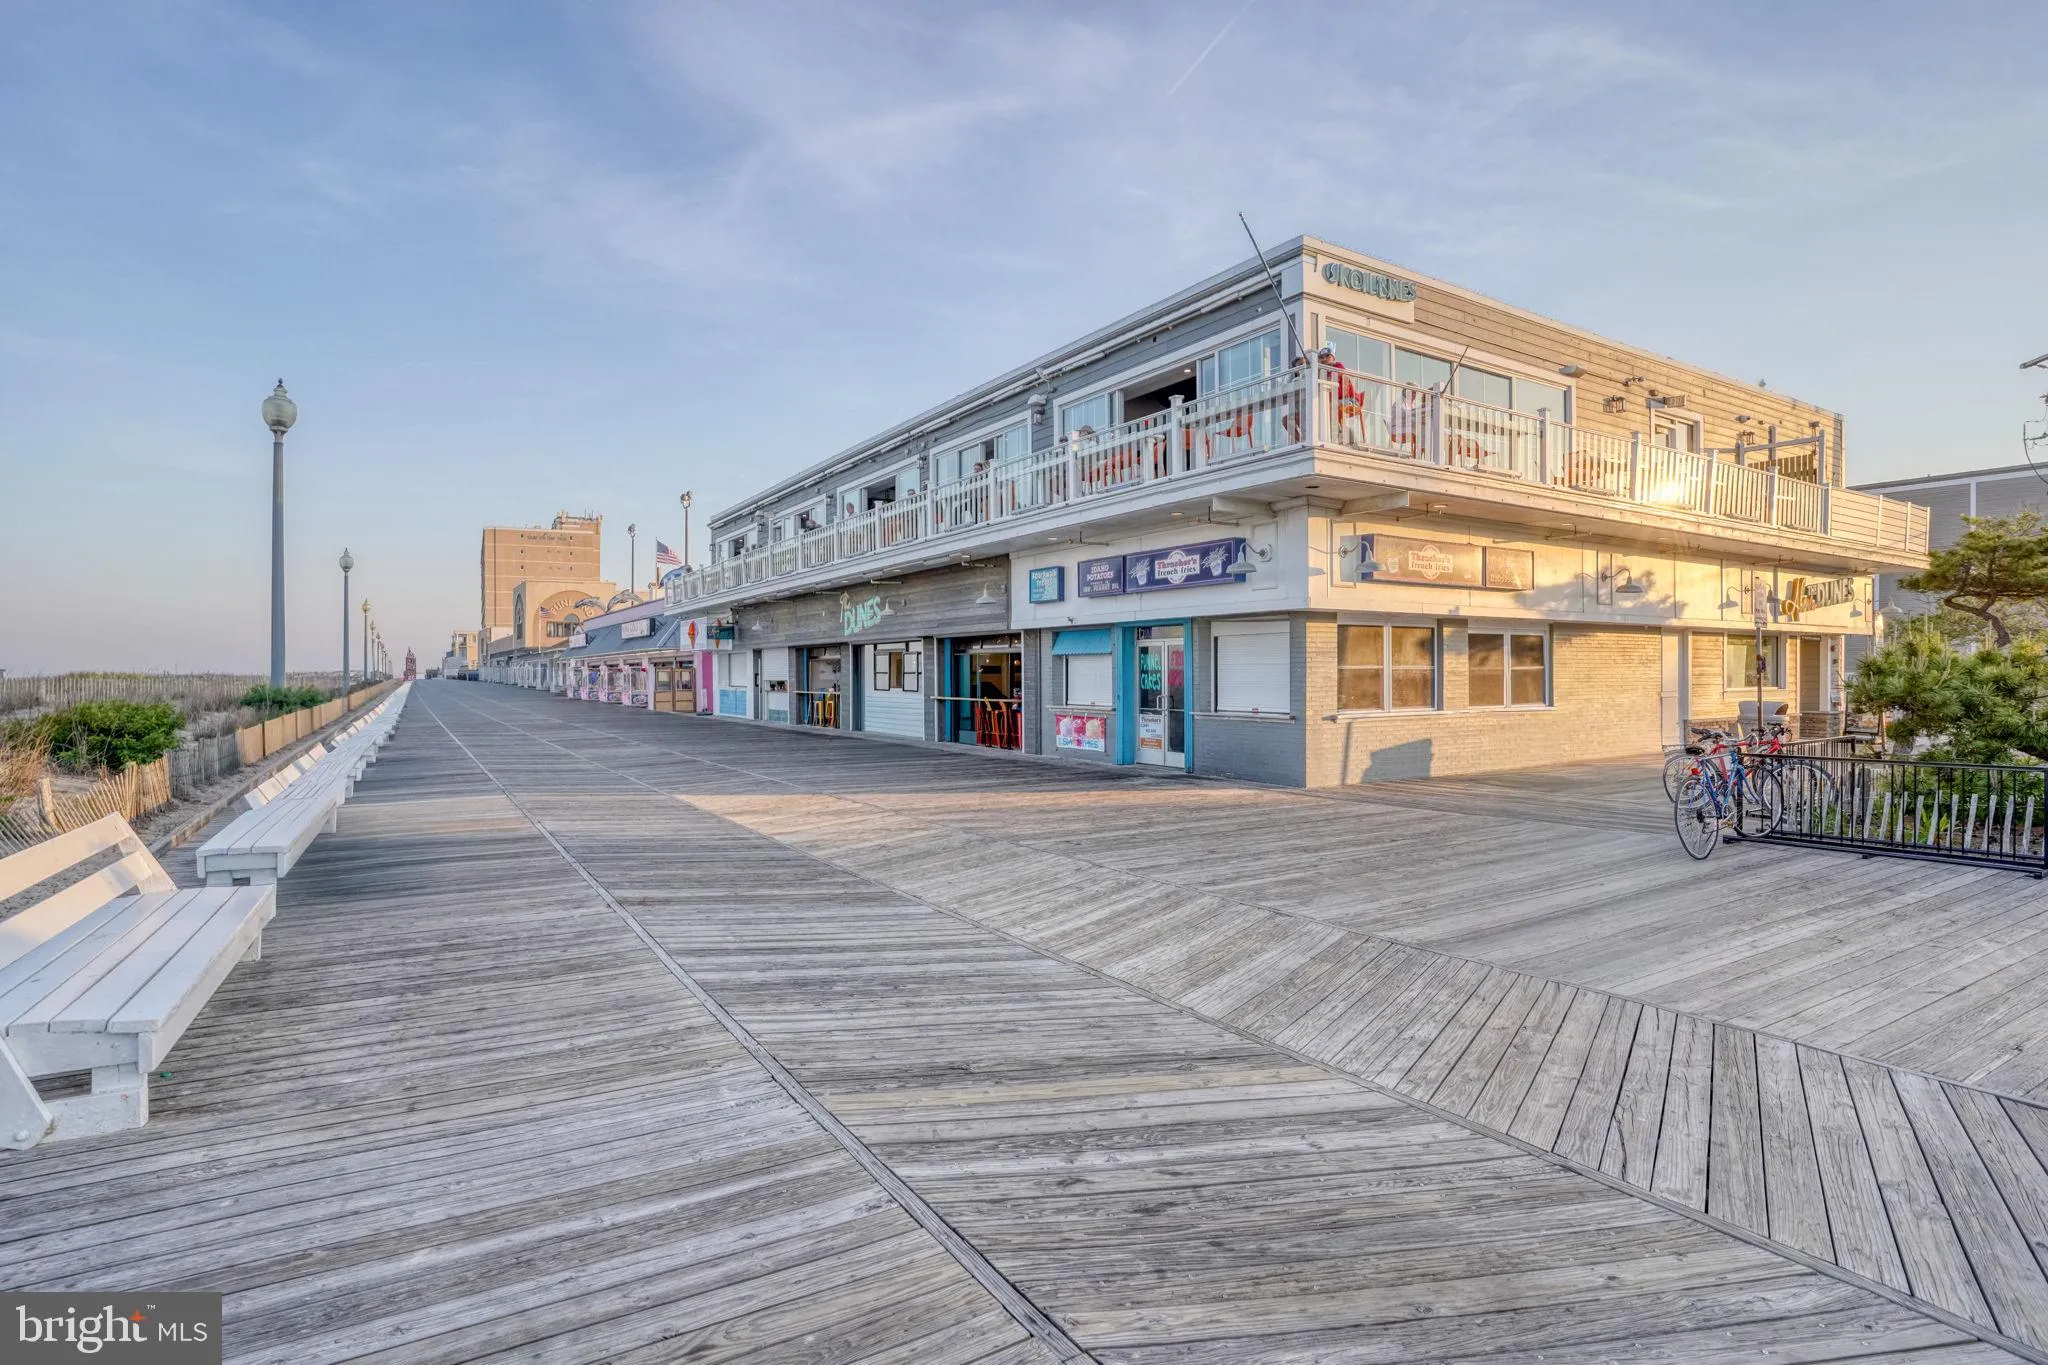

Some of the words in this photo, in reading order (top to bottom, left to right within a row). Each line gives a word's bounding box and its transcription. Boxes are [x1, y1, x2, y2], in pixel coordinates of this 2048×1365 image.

[1411, 552, 1451, 563] Thrasher's
[1091, 564, 1109, 573] IDAHO
[1157, 557, 1198, 570] Thrasher's
[1411, 561, 1433, 570] french
[1435, 563, 1450, 571] fries
[1086, 571, 1114, 581] POTATOES
[1157, 567, 1179, 577] french
[1180, 566, 1197, 574] fries
[1816, 577, 1855, 607] DUNES
[844, 595, 881, 636] DUNES
